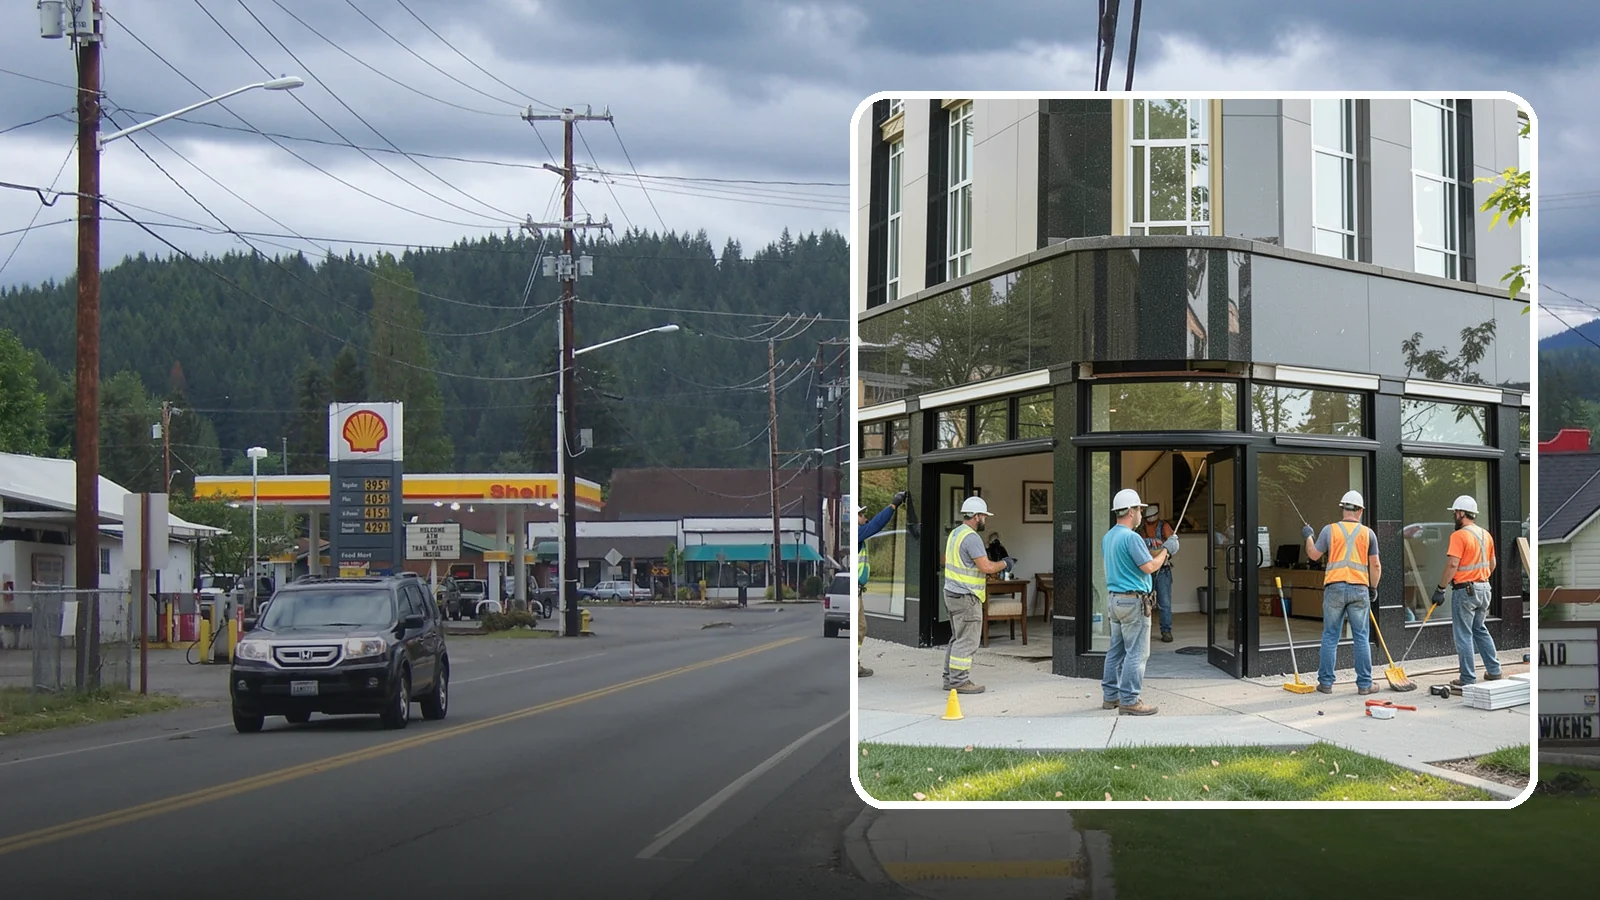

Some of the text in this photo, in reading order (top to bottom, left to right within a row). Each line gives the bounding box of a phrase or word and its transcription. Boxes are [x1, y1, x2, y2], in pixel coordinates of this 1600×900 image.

[365, 480, 383, 490] 395
[490, 484, 547, 499] Shell
[365, 494, 383, 504] 405
[365, 508, 383, 518] 415
[365, 522, 383, 532] 429
